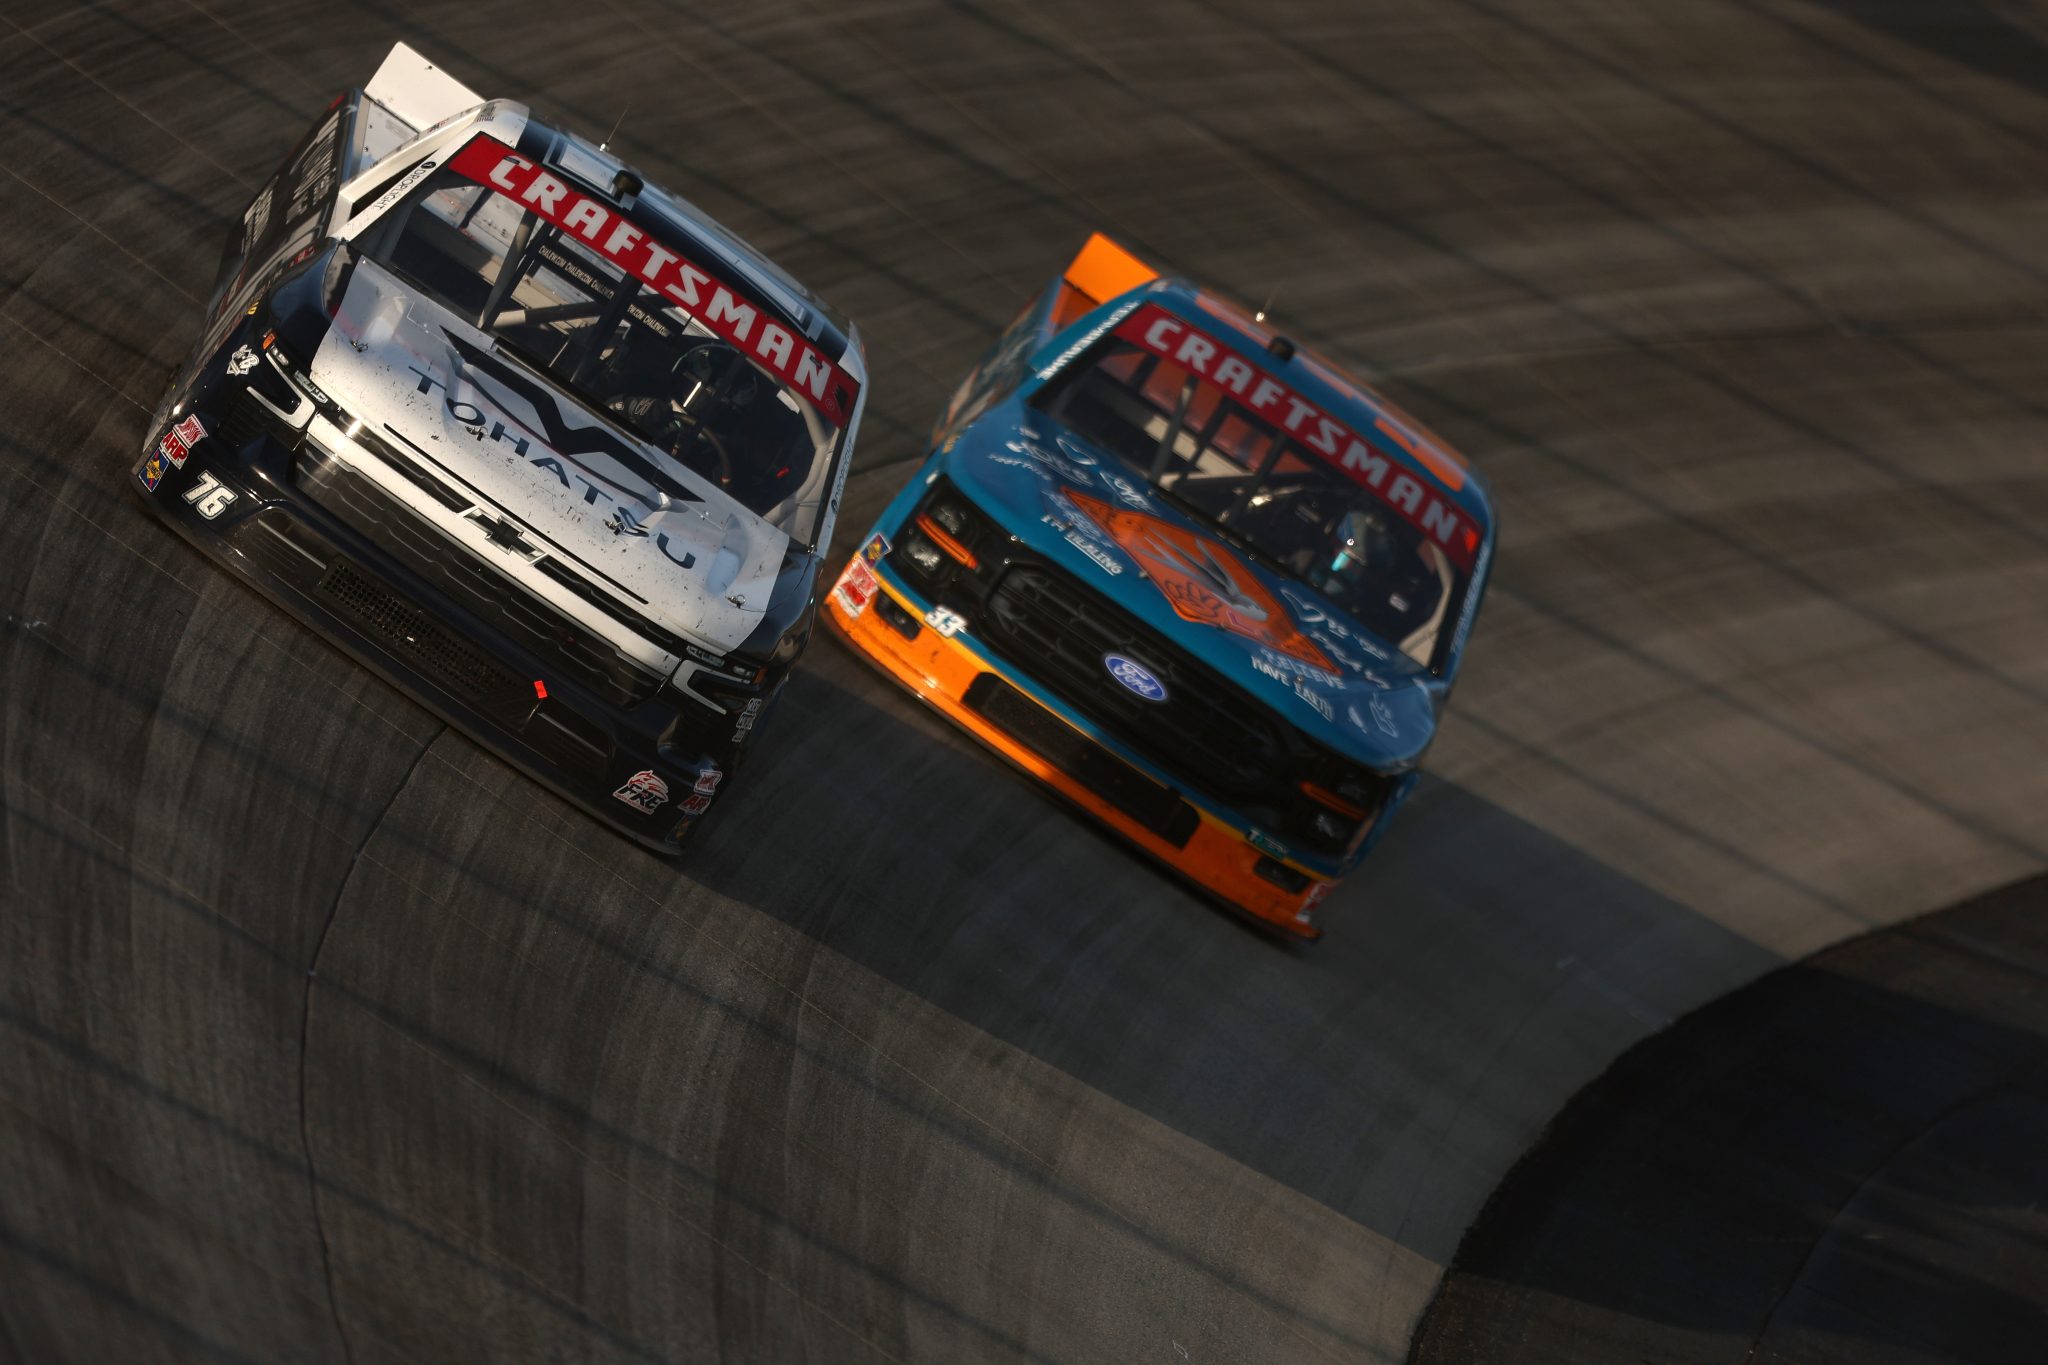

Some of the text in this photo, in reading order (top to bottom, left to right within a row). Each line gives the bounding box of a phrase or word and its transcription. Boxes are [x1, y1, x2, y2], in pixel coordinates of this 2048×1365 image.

[374, 169, 426, 211] DROPLIGHT
[488, 156, 831, 401] CRAFTSMAN
[162, 431, 188, 461] ARP
[1146, 318, 1459, 543] CRAFTSMAN
[408, 366, 696, 569] TOHATSU
[181, 470, 238, 520] 76
[1112, 661, 1159, 697] Ford
